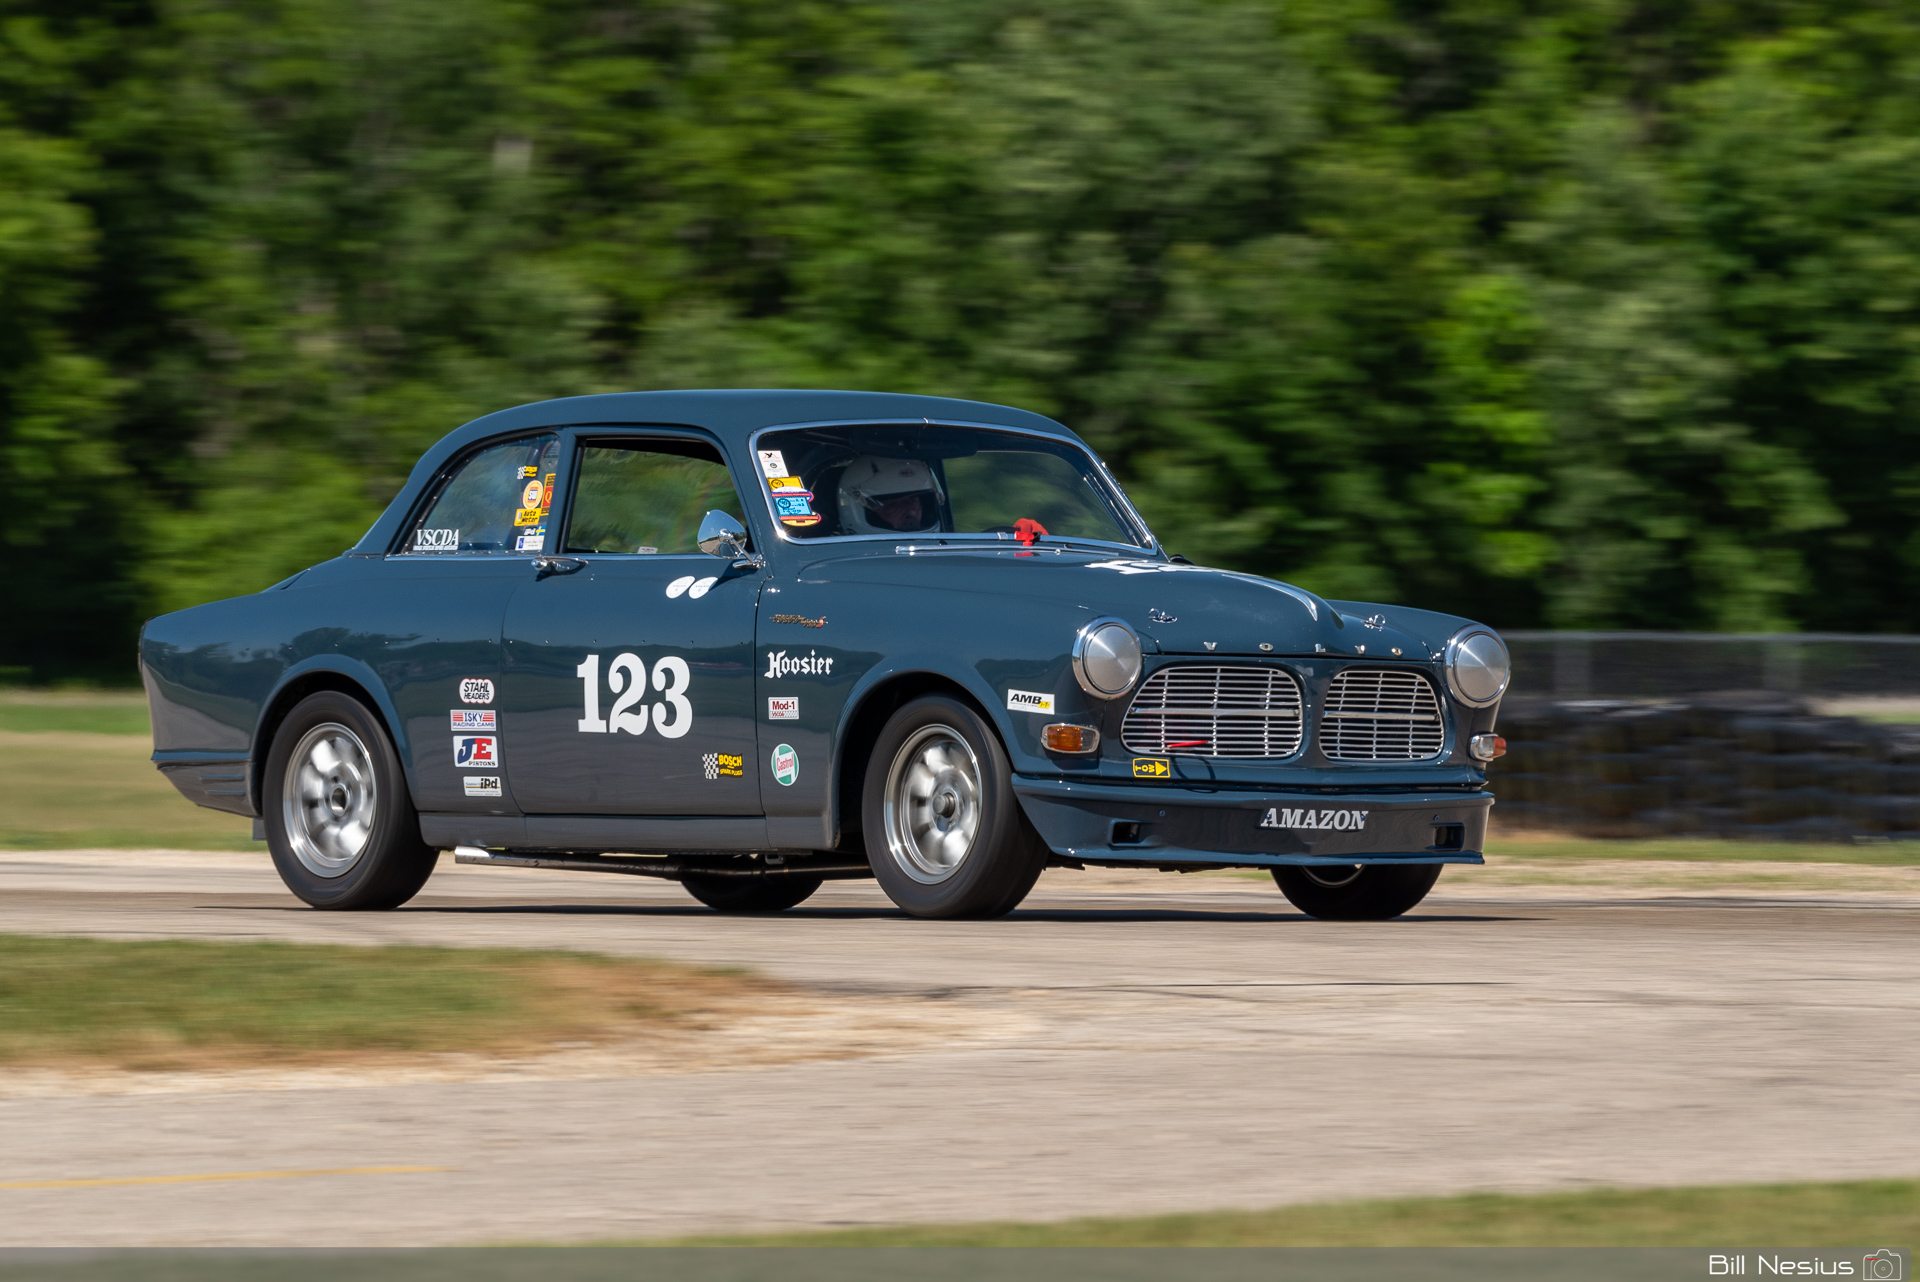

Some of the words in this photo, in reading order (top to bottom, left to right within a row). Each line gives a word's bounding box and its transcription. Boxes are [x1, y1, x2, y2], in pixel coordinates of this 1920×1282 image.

[417, 529, 459, 546] VSCDA
[1203, 641, 1403, 656] VOLVO
[764, 649, 834, 679] Hoosier
[464, 682, 490, 693] STAHL
[464, 692, 490, 700] HEADERS
[577, 652, 693, 739] 123
[1010, 693, 1042, 705] AMB
[772, 701, 795, 710] Mod-1
[464, 712, 484, 722] ISKY
[457, 738, 492, 765] JE
[718, 754, 743, 767] BOSCH
[776, 753, 794, 772] Castrol
[1134, 764, 1155, 774] TOW
[1260, 807, 1369, 830] AMAZON
